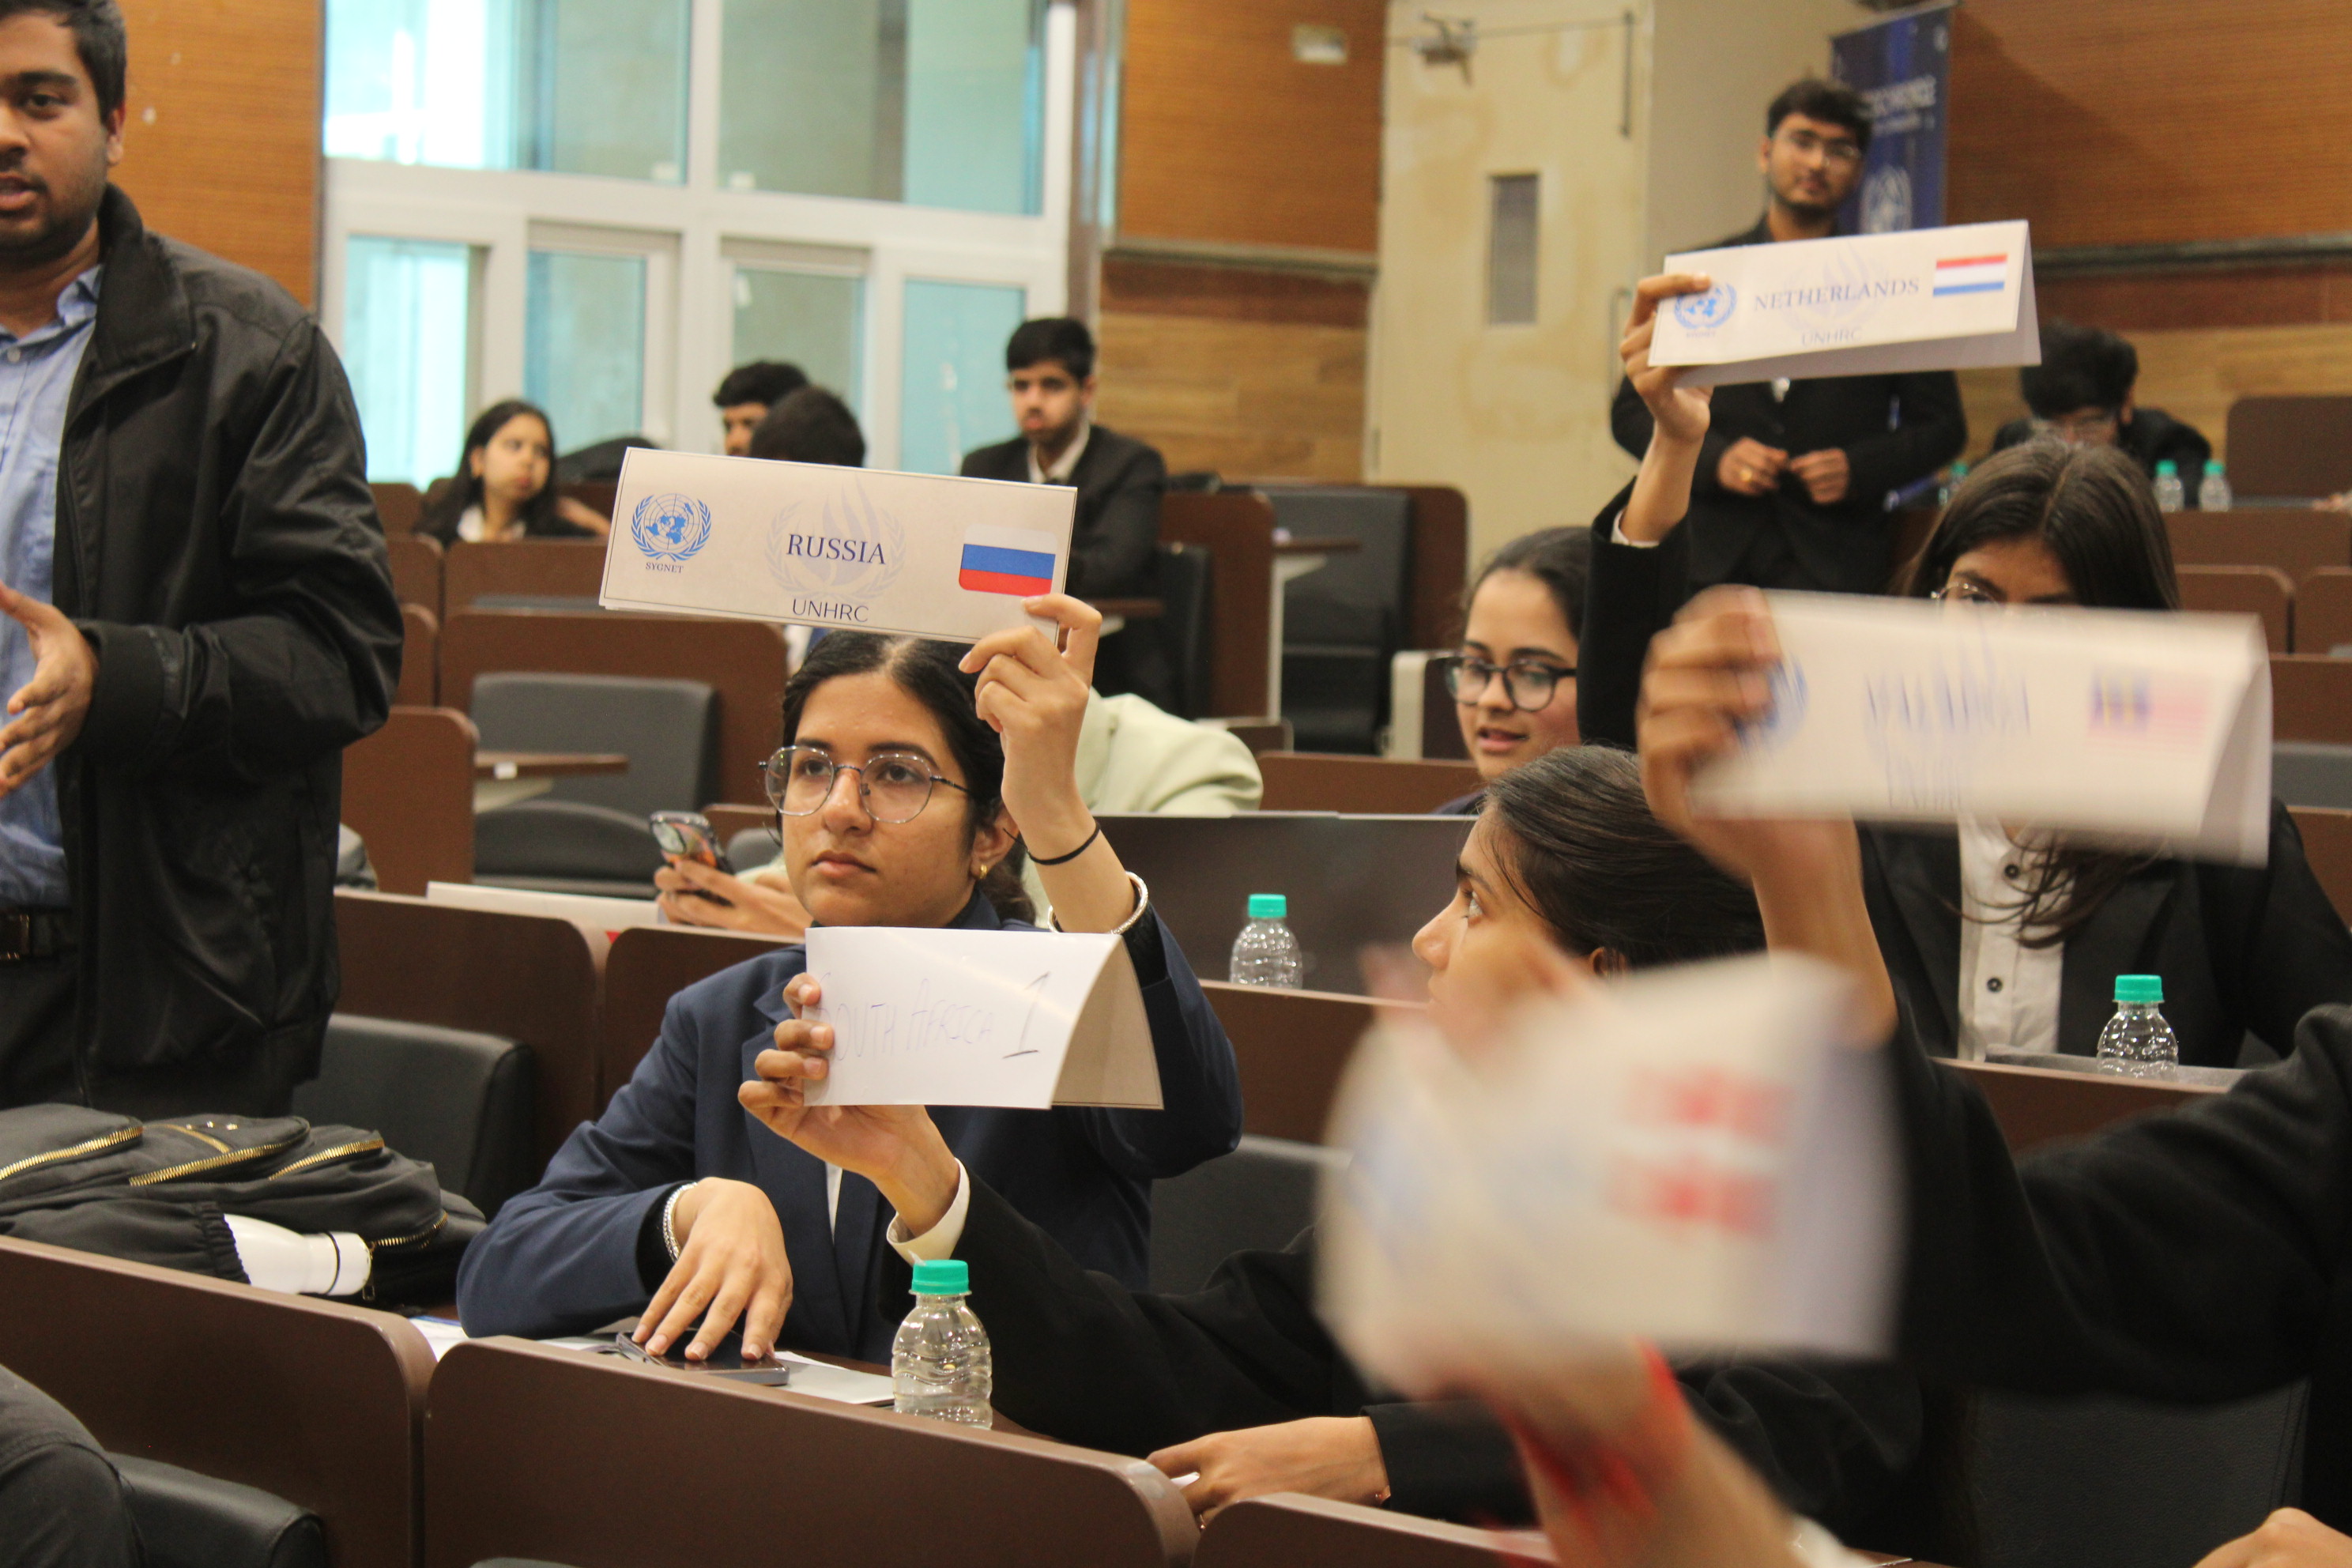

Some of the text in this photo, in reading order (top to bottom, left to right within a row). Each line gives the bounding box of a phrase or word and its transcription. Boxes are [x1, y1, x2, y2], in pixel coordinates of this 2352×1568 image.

[1754, 277, 1920, 311] NETHERLANDS
[1801, 326, 1864, 347] UNHRC
[786, 533, 887, 565] RUSSIA
[645, 562, 684, 575] SYGNET
[792, 598, 870, 623] UNHRC
